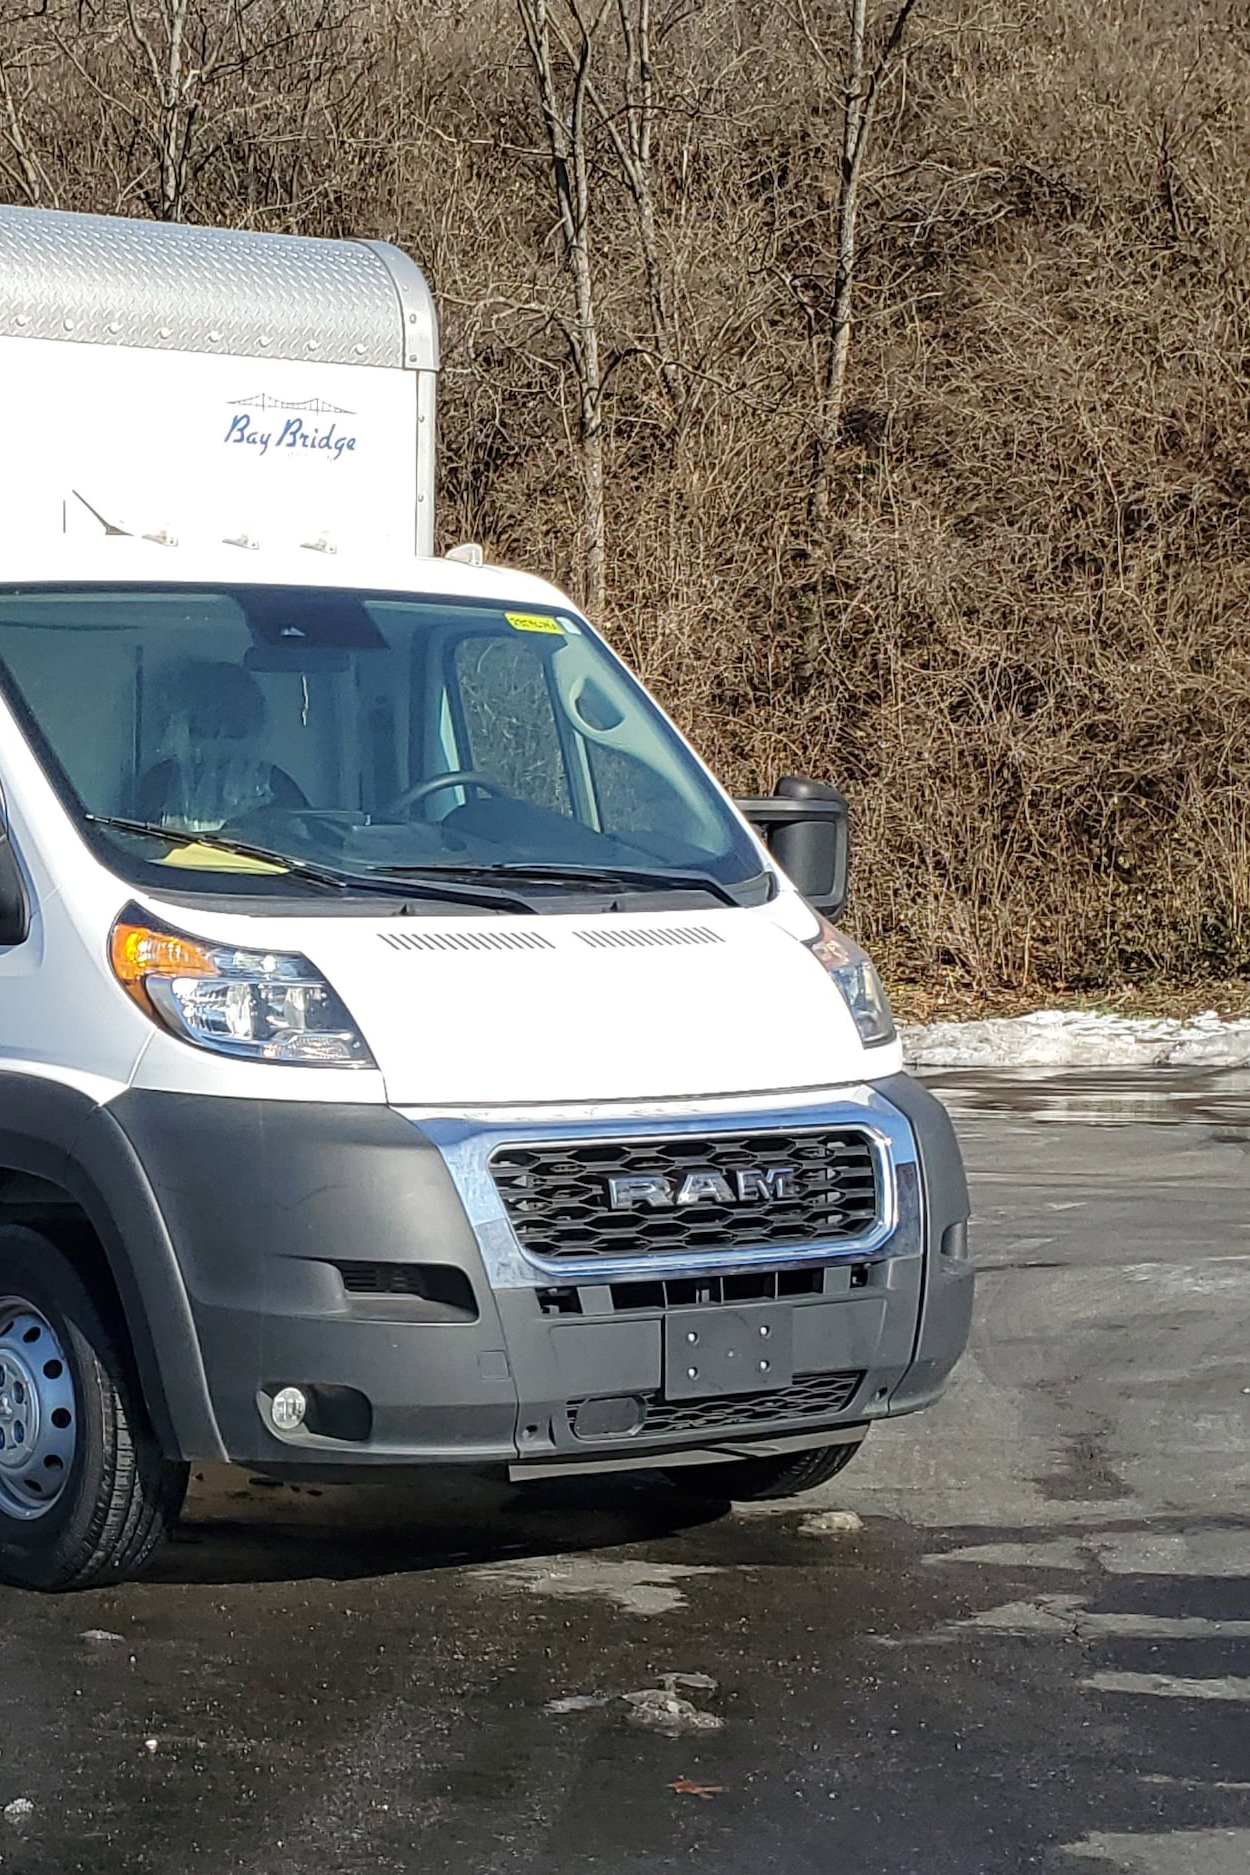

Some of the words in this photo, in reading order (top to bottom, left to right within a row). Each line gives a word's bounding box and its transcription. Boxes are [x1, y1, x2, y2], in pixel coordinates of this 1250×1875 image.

[224, 414, 271, 456] Bay
[275, 418, 356, 460] Bridge
[608, 1167, 797, 1210] RAM
